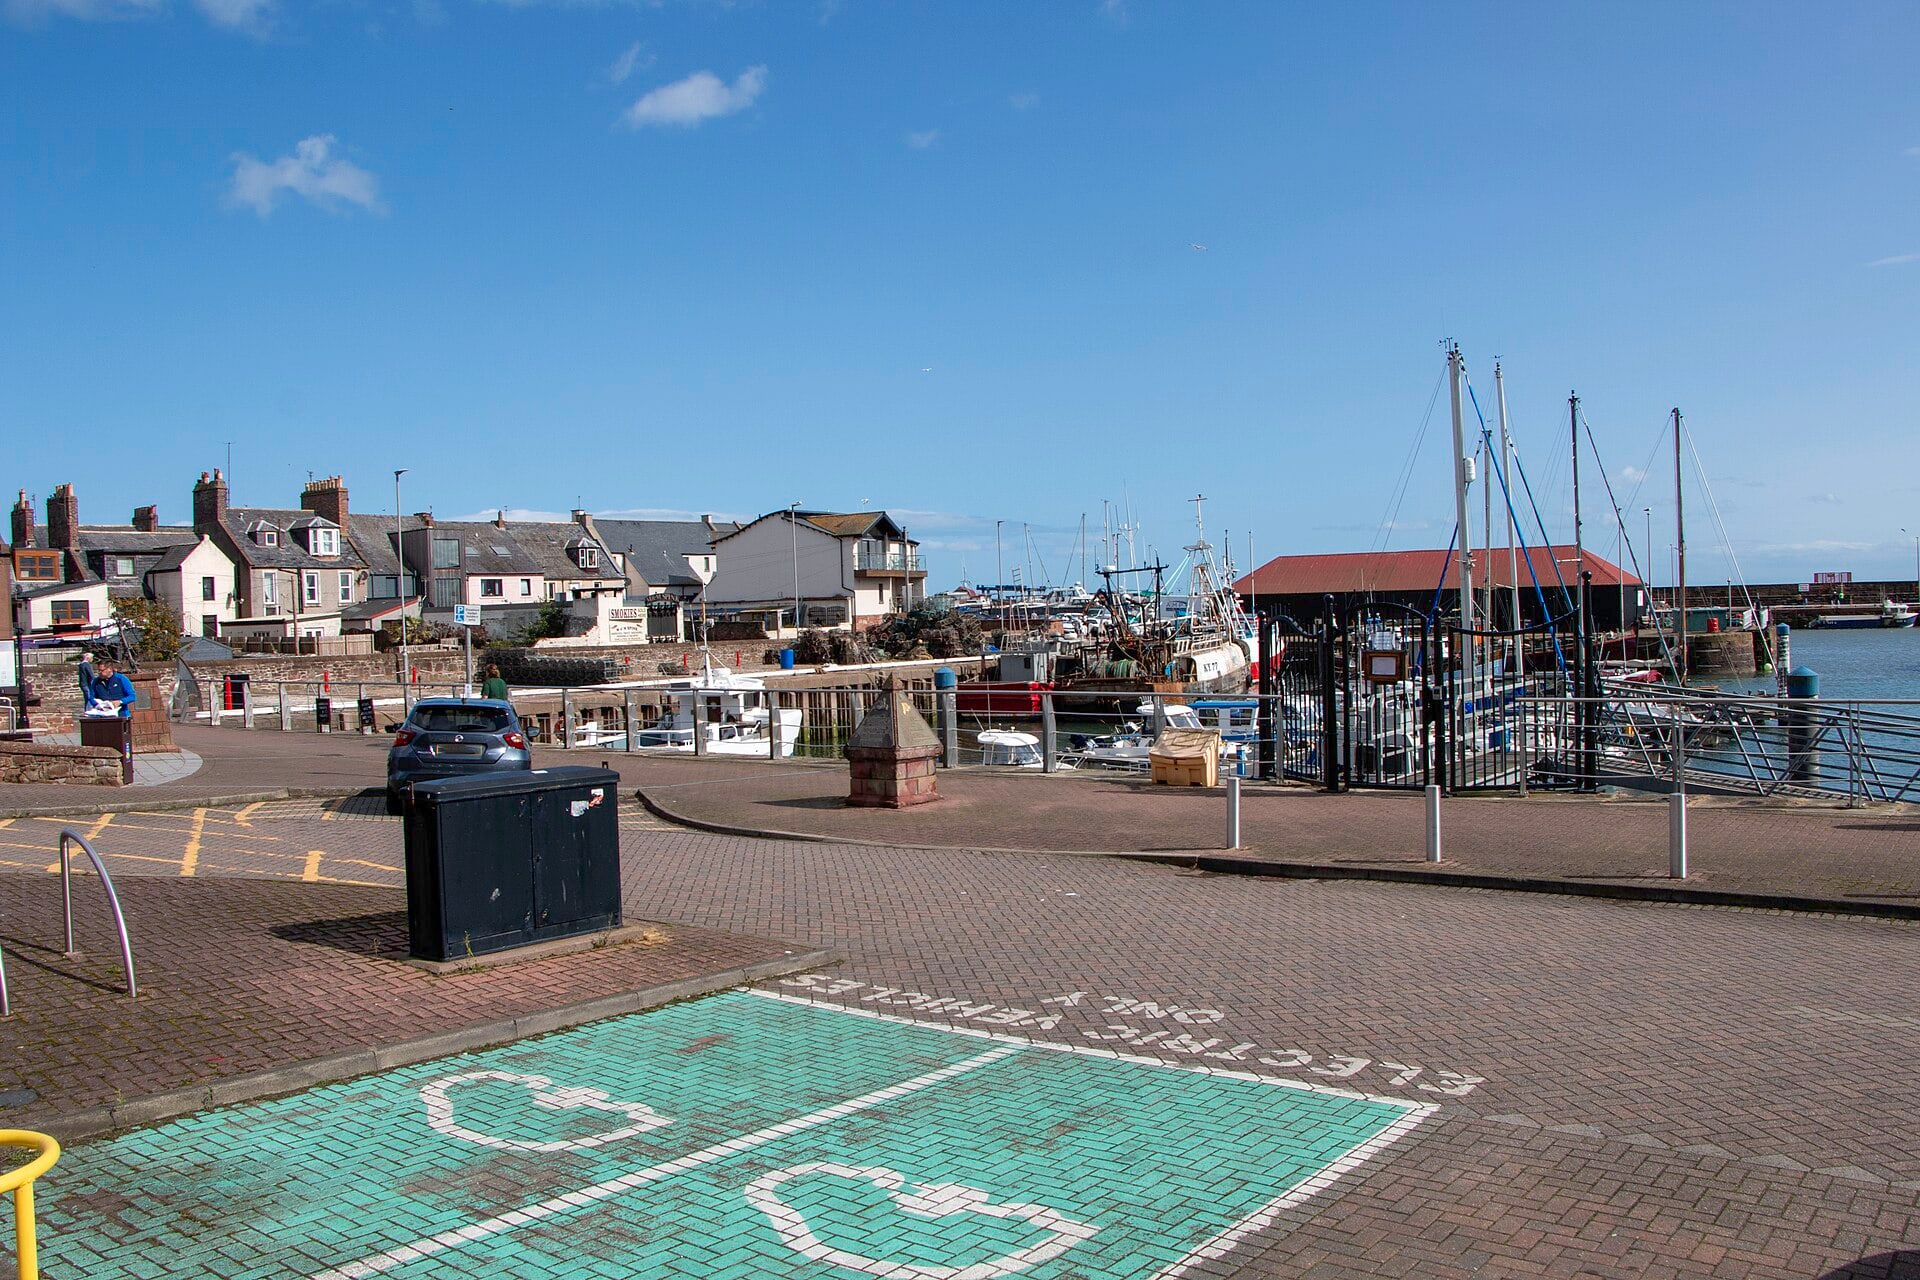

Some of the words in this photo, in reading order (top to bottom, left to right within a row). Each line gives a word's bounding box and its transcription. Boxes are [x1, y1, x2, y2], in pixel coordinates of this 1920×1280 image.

[611, 608, 637, 619] SMOKIES
[779, 973, 1064, 1030] VEHICLES
[1040, 990, 1225, 1024] ONLY
[1082, 1024, 1487, 1097] ELECTRIC
